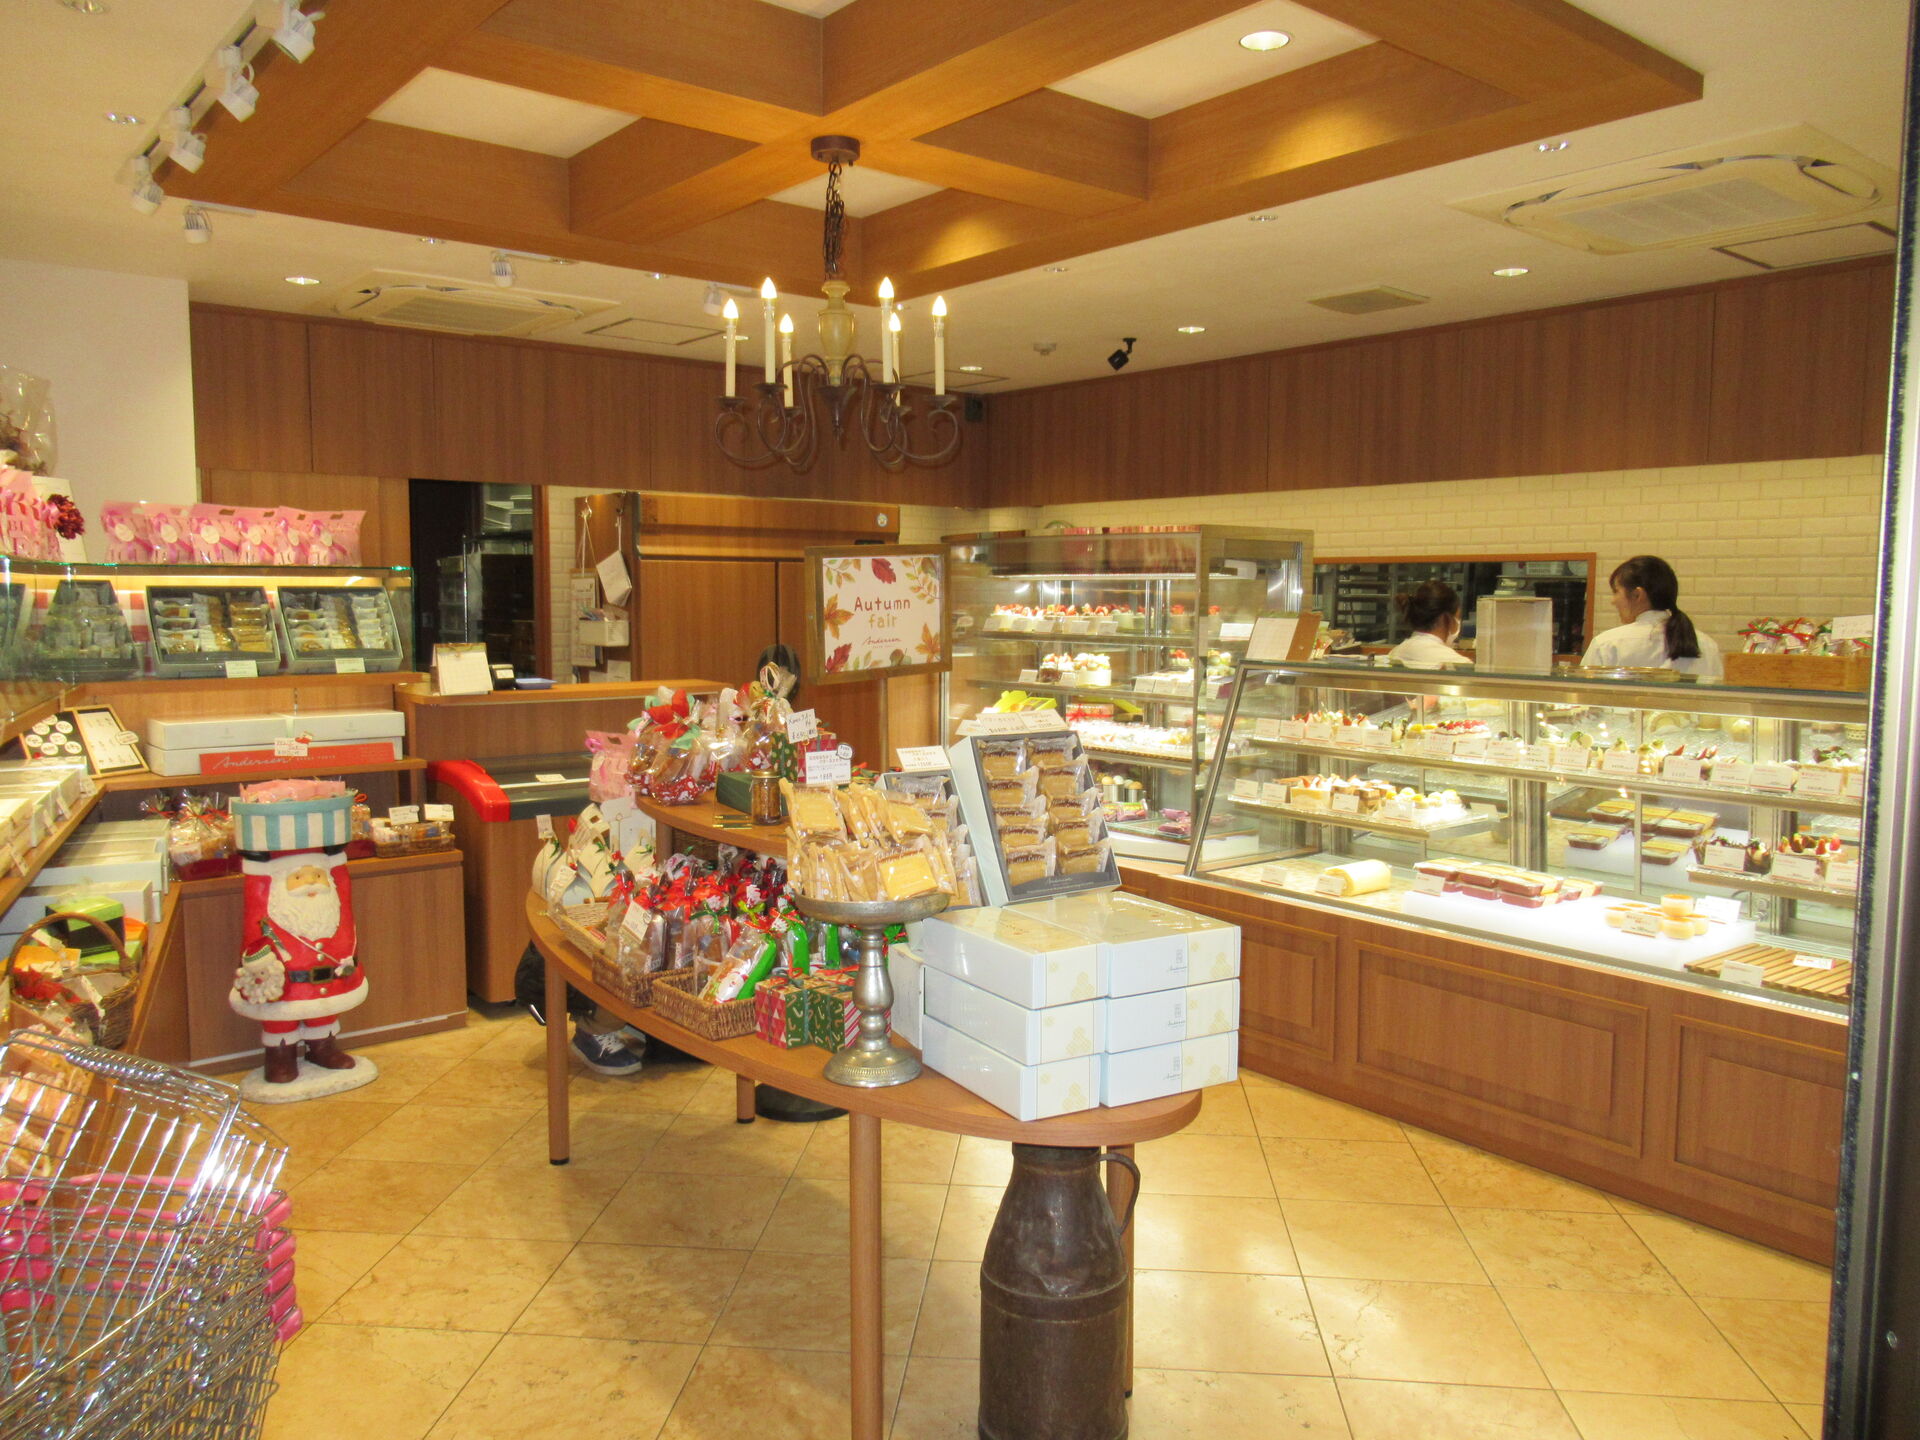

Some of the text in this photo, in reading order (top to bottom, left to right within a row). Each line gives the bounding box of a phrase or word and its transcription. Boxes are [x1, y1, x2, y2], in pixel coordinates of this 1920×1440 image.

[854, 596, 911, 612] Autumn
[868, 613, 897, 629] fair
[212, 755, 289, 770] Andersen
